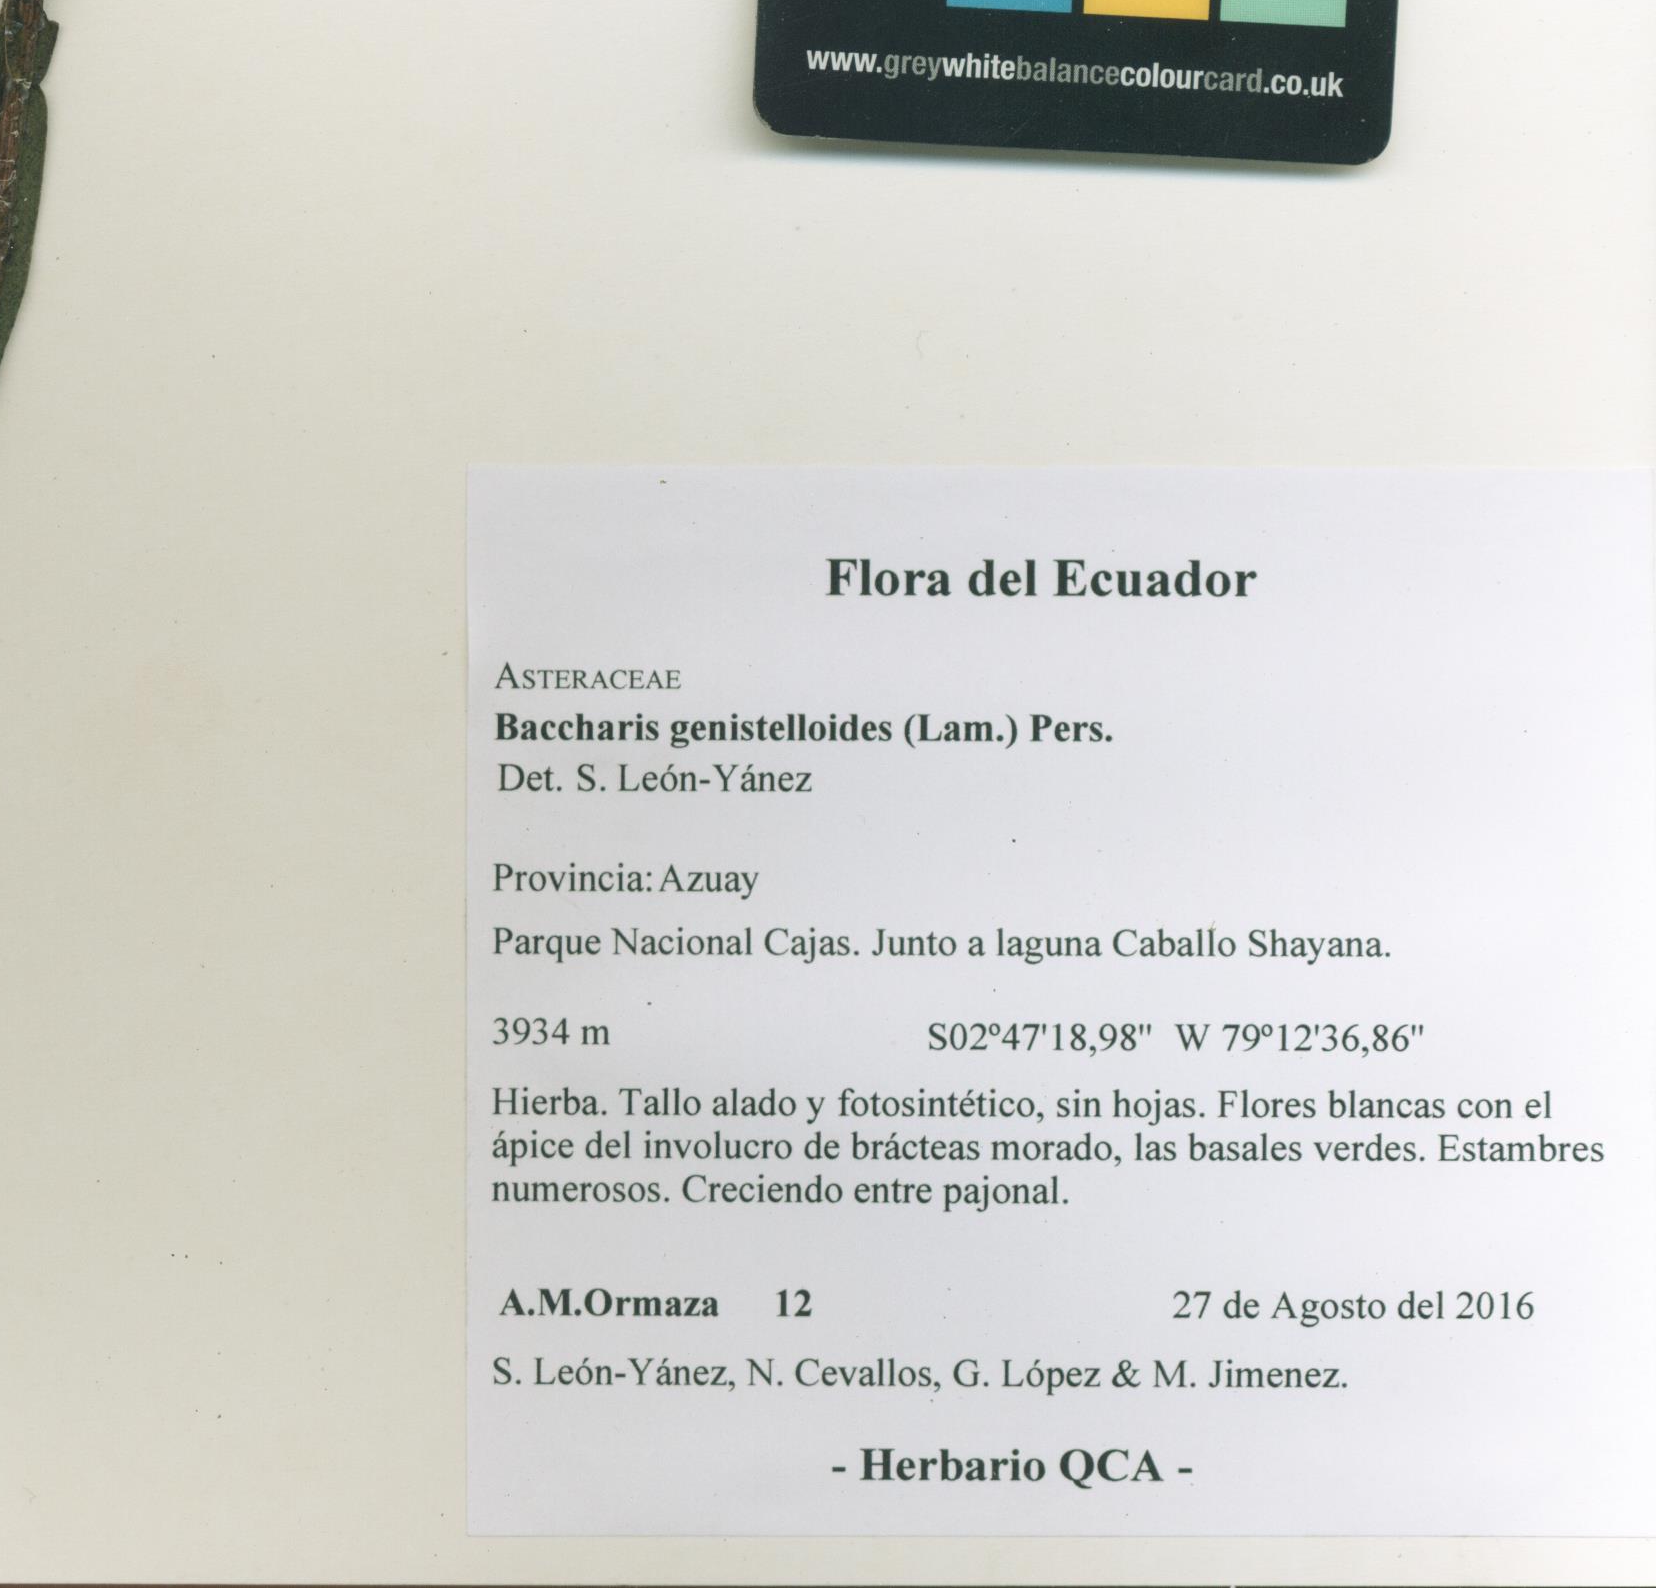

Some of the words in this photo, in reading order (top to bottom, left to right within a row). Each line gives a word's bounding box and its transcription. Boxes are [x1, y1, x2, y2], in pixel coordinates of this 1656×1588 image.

[806, 49, 1345, 97] www.greywhitebalancecolourcard.co.uk
[826, 558, 952, 597] Flora
[968, 559, 1037, 597] del
[1053, 559, 1257, 598] Ecuador
[495, 712, 660, 742] Baccharis
[670, 712, 893, 749] genistelloides
[904, 713, 1018, 749] (Lam.)
[1030, 714, 1113, 743] Pers.
[498, 763, 563, 792] Det.
[577, 763, 606, 792] S.
[619, 763, 813, 793] León-Yánez
[493, 862, 652, 893] Provincia:
[659, 864, 759, 901] Azuay
[493, 927, 601, 964] Parque
[611, 926, 753, 956] Nacional
[764, 927, 860, 964] Cajas.
[871, 928, 957, 957] Junto
[968, 936, 985, 957] a
[997, 927, 1102, 965] laguna
[1112, 928, 1236, 957] Caballo
[1248, 928, 1390, 966] Shayana.
[492, 1017, 570, 1045] 3934
[581, 1025, 610, 1045] m
[1175, 1024, 1210, 1051] W
[492, 1086, 607, 1116] Hierba.
[618, 1087, 702, 1117] Tallo
[712, 1087, 797, 1117] alado
[806, 1096, 825, 1125] y
[838, 1087, 1044, 1123] fotosintético,
[1056, 1088, 1101, 1118] sin
[1113, 1088, 1205, 1126] hojas.
[1218, 1089, 1316, 1119] Flores
[1329, 1089, 1446, 1119] blancas
[1457, 1098, 1512, 1119] con
[1525, 1090, 1551, 1119] el
[492, 1129, 574, 1168] ápice
[585, 1129, 631, 1159] del
[644, 1130, 793, 1160] involucro
[803, 1130, 840, 1160] de
[851, 1131, 981, 1161] brácteas
[991, 1132, 1122, 1166] morado,
[1135, 1132, 1177, 1162] las
[1188, 1132, 1302, 1162] basales
[1313, 1133, 1425, 1162] verdes.
[1439, 1134, 1604, 1162] Estambres
[492, 1181, 670, 1203] numerosos.
[681, 1173, 843, 1204] Creciendo
[853, 1178, 933, 1204] entre
[943, 1175, 1069, 1213] pajonal.
[499, 1288, 719, 1318] A.M.Ormaza
[777, 1288, 812, 1317] 12
[1173, 1290, 1211, 1319] 27
[1223, 1290, 1260, 1319] de
[1271, 1291, 1386, 1328] Agosto
[1397, 1290, 1444, 1320] del
[1456, 1291, 1534, 1320] 2016
[493, 1356, 522, 1385] S.
[534, 1357, 736, 1391] León-Yánez,
[746, 1358, 783, 1387] N.
[795, 1357, 941, 1393] Cevallos,
[953, 1358, 989, 1388] G.
[1002, 1359, 1101, 1396] López
[1111, 1359, 1141, 1388] &
[1154, 1360, 1196, 1388] M.
[1208, 1359, 1347, 1388] Jimenez.
[860, 1448, 1046, 1482] Herbario
[1059, 1448, 1164, 1490] QCA
